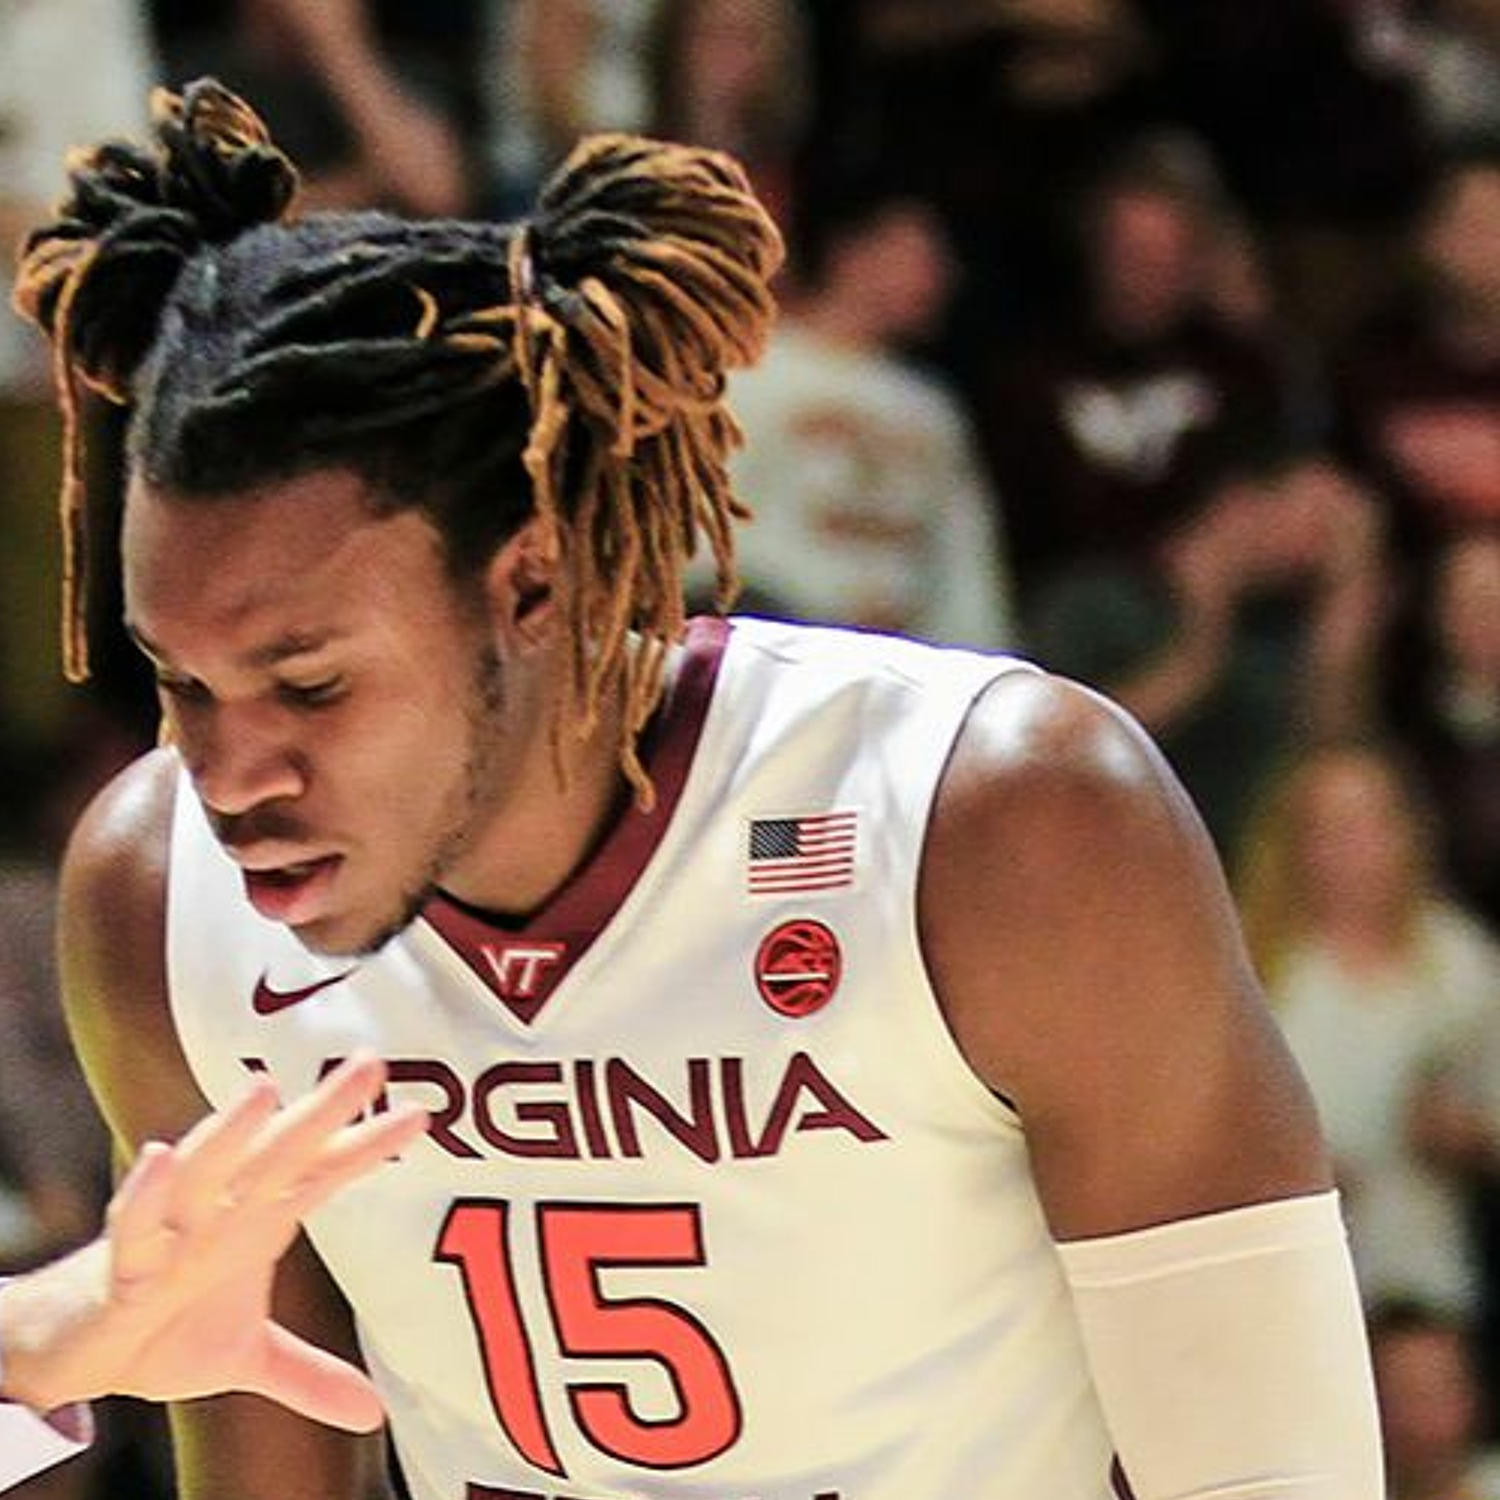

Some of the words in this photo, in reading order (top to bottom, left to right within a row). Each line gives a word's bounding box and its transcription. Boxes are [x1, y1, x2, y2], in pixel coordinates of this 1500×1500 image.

[480, 943, 566, 995] VT
[240, 1051, 890, 1163] RGINIA
[432, 1197, 744, 1478] 15
